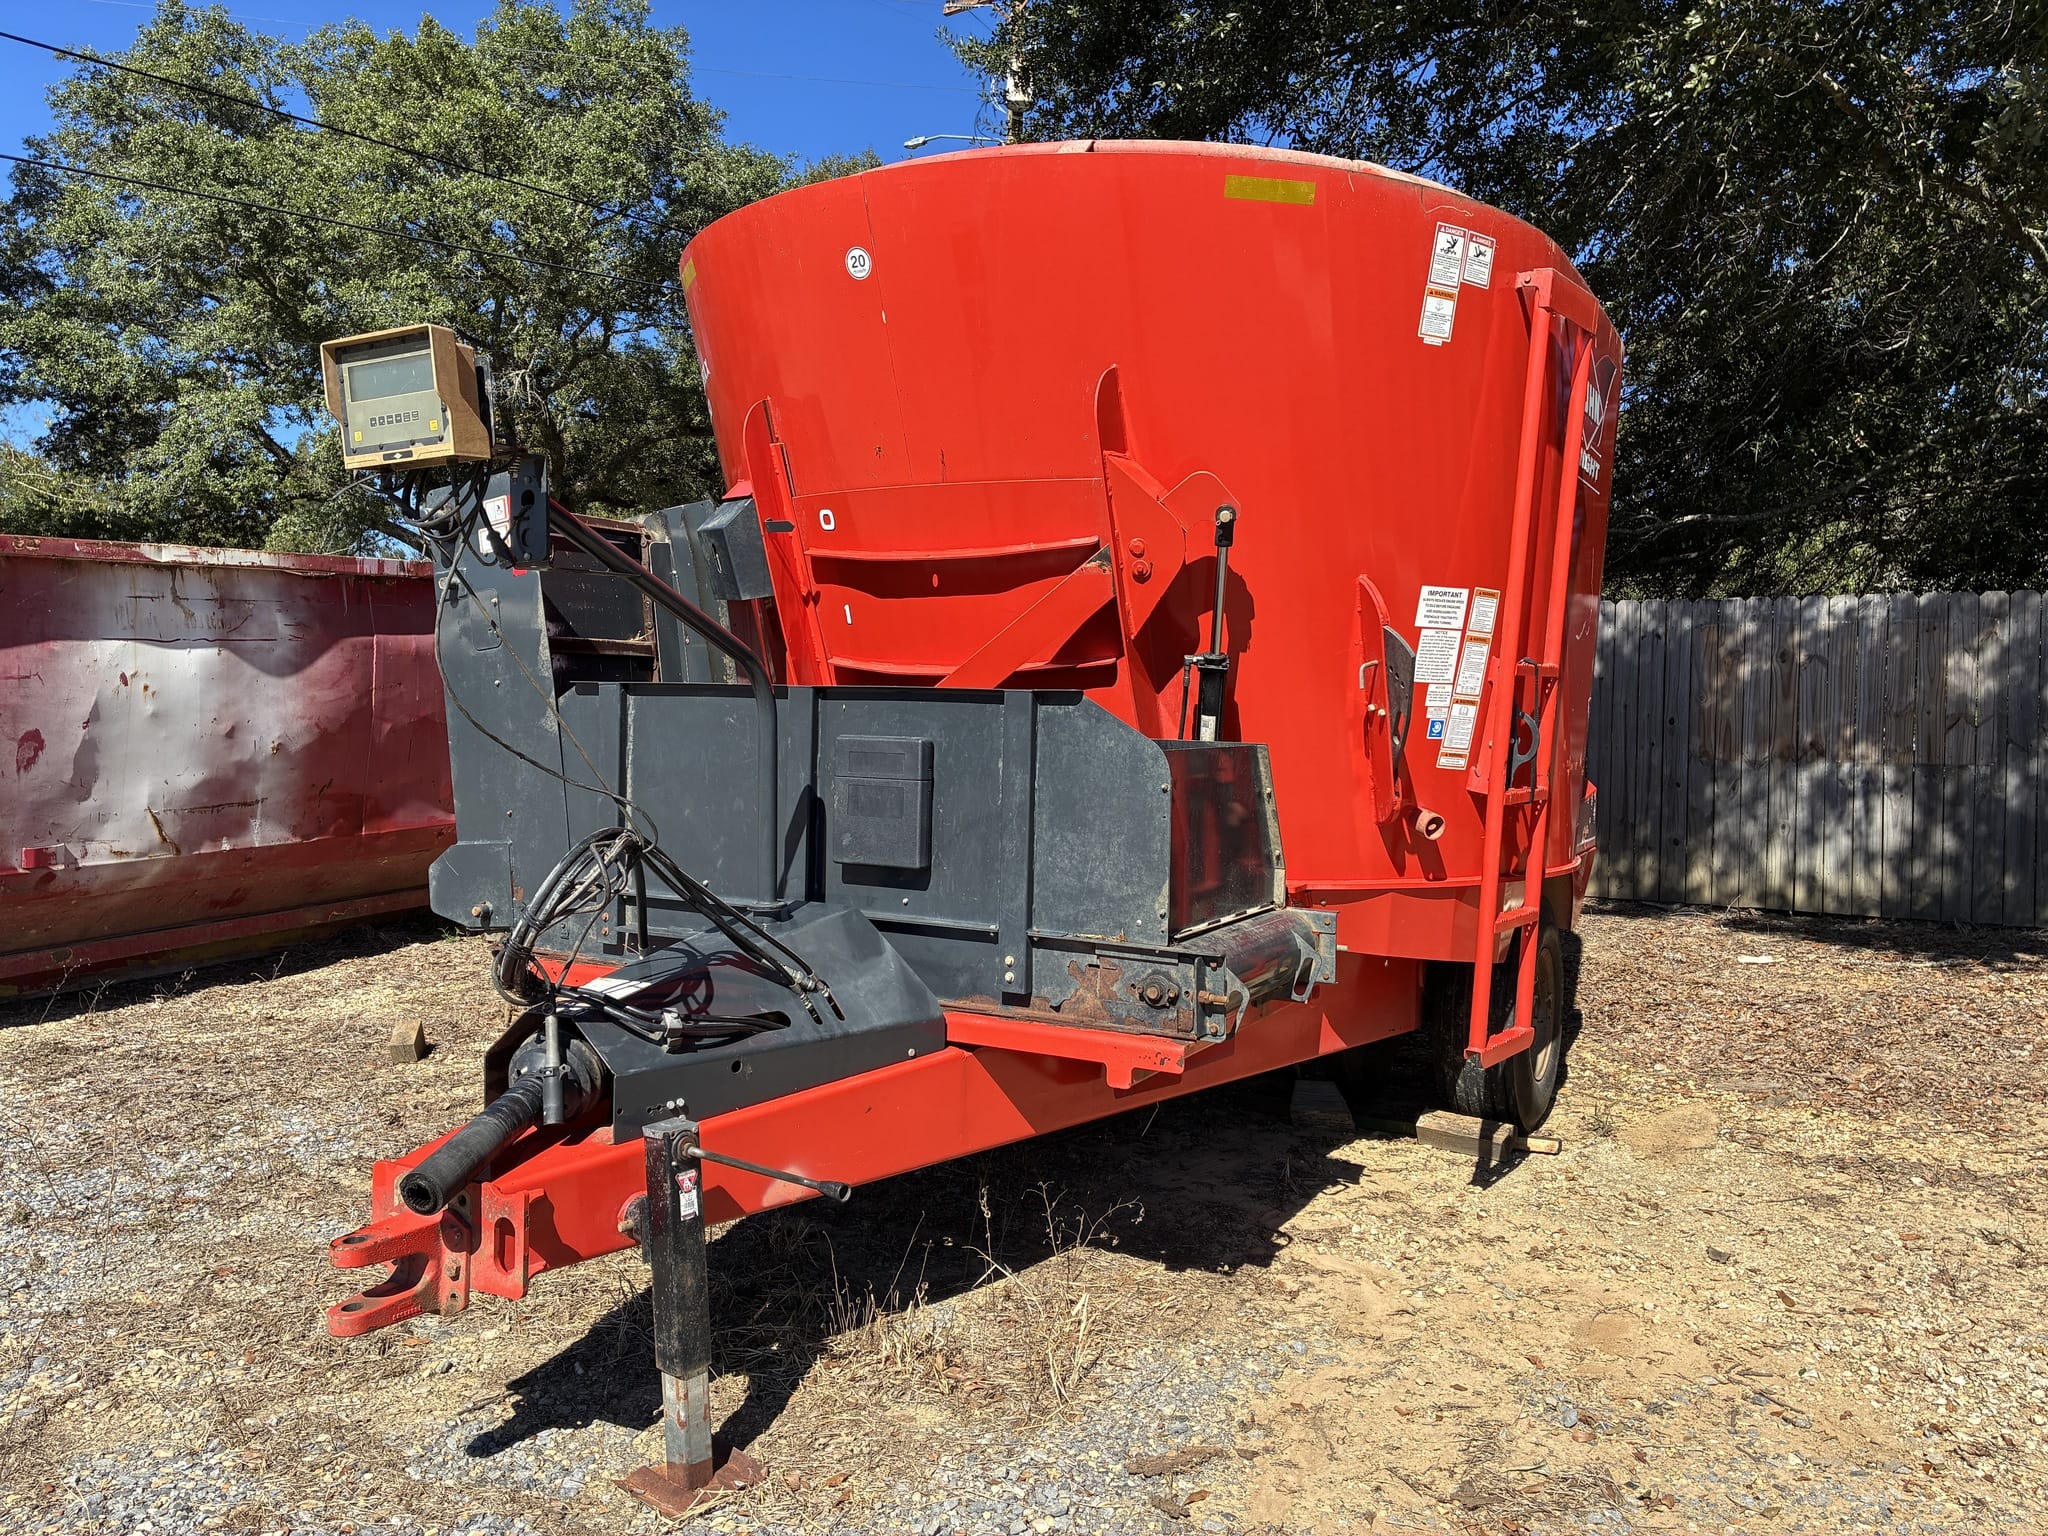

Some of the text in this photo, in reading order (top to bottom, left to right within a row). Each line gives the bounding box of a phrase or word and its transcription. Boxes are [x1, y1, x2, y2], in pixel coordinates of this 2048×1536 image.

[850, 254, 866, 268] 20
[1580, 447, 1600, 481] NIGHT
[1427, 590, 1463, 598] IMPORTANT
